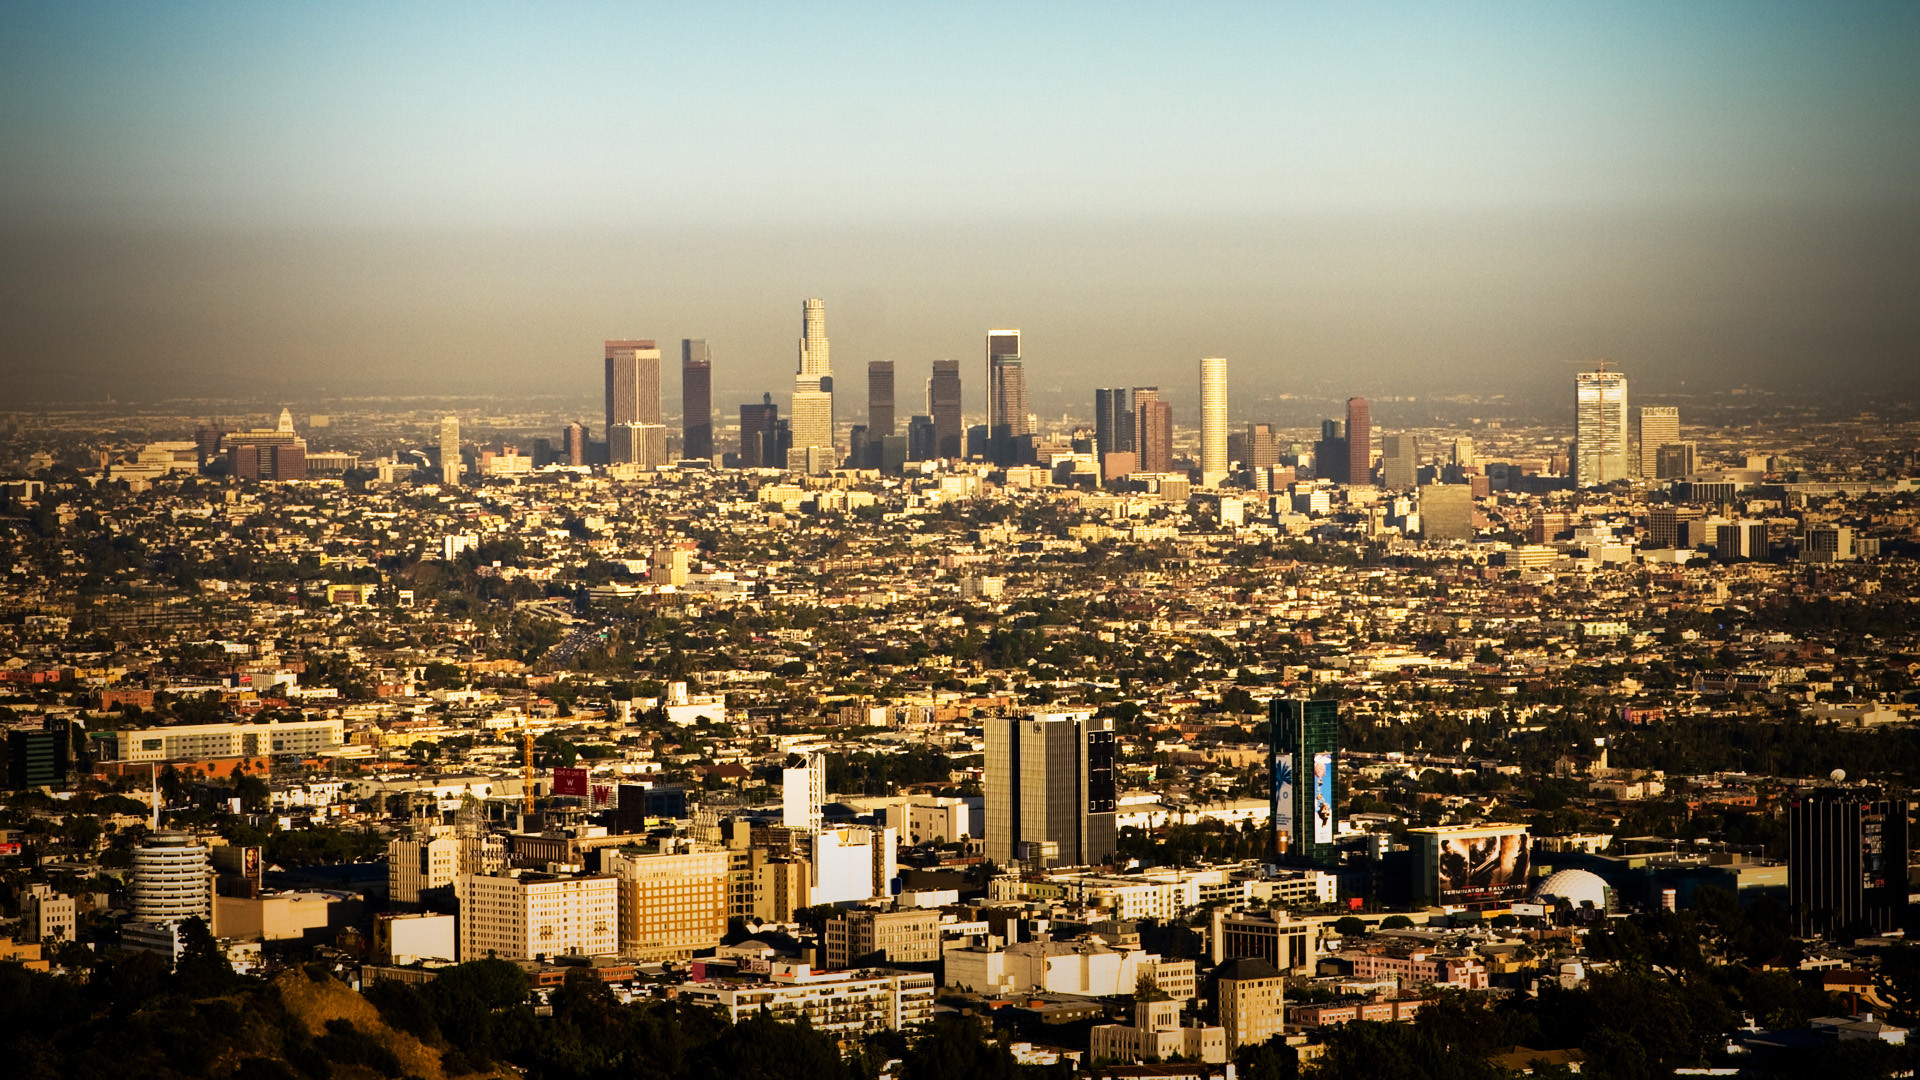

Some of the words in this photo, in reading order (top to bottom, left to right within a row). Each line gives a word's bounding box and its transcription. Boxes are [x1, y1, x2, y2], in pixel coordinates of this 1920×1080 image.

[592, 785, 610, 804] W
[1443, 887, 1485, 895] TERMINATOR
[1487, 884, 1528, 892] SALVATION
